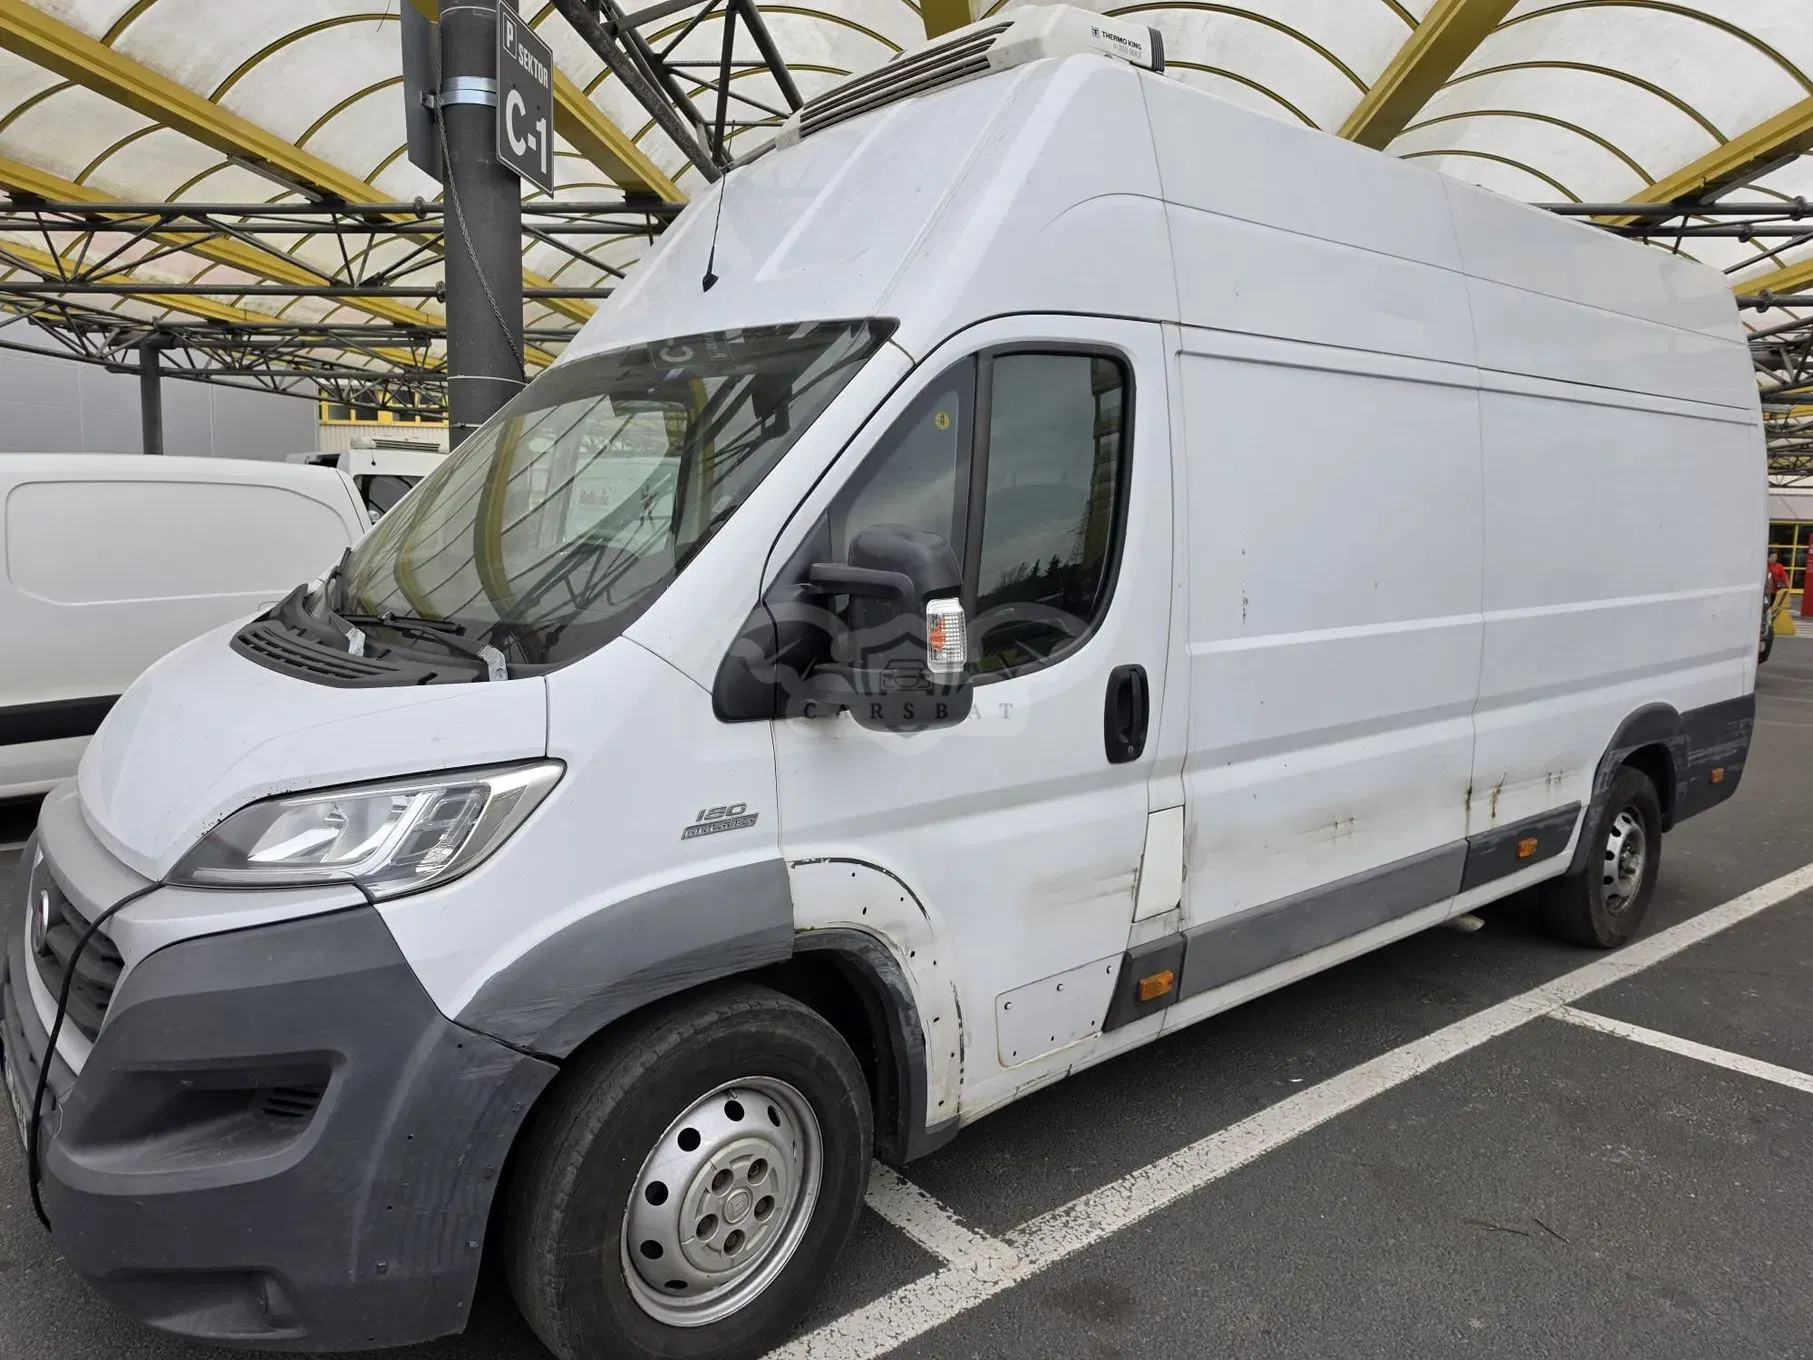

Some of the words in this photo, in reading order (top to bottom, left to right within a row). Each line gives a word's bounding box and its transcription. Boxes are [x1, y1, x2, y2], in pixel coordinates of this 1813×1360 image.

[505, 19, 514, 49] P
[518, 43, 549, 90] SEKTOR
[1101, 30, 1128, 46] THERMO
[1128, 39, 1142, 51] KING
[505, 89, 547, 175] C-1
